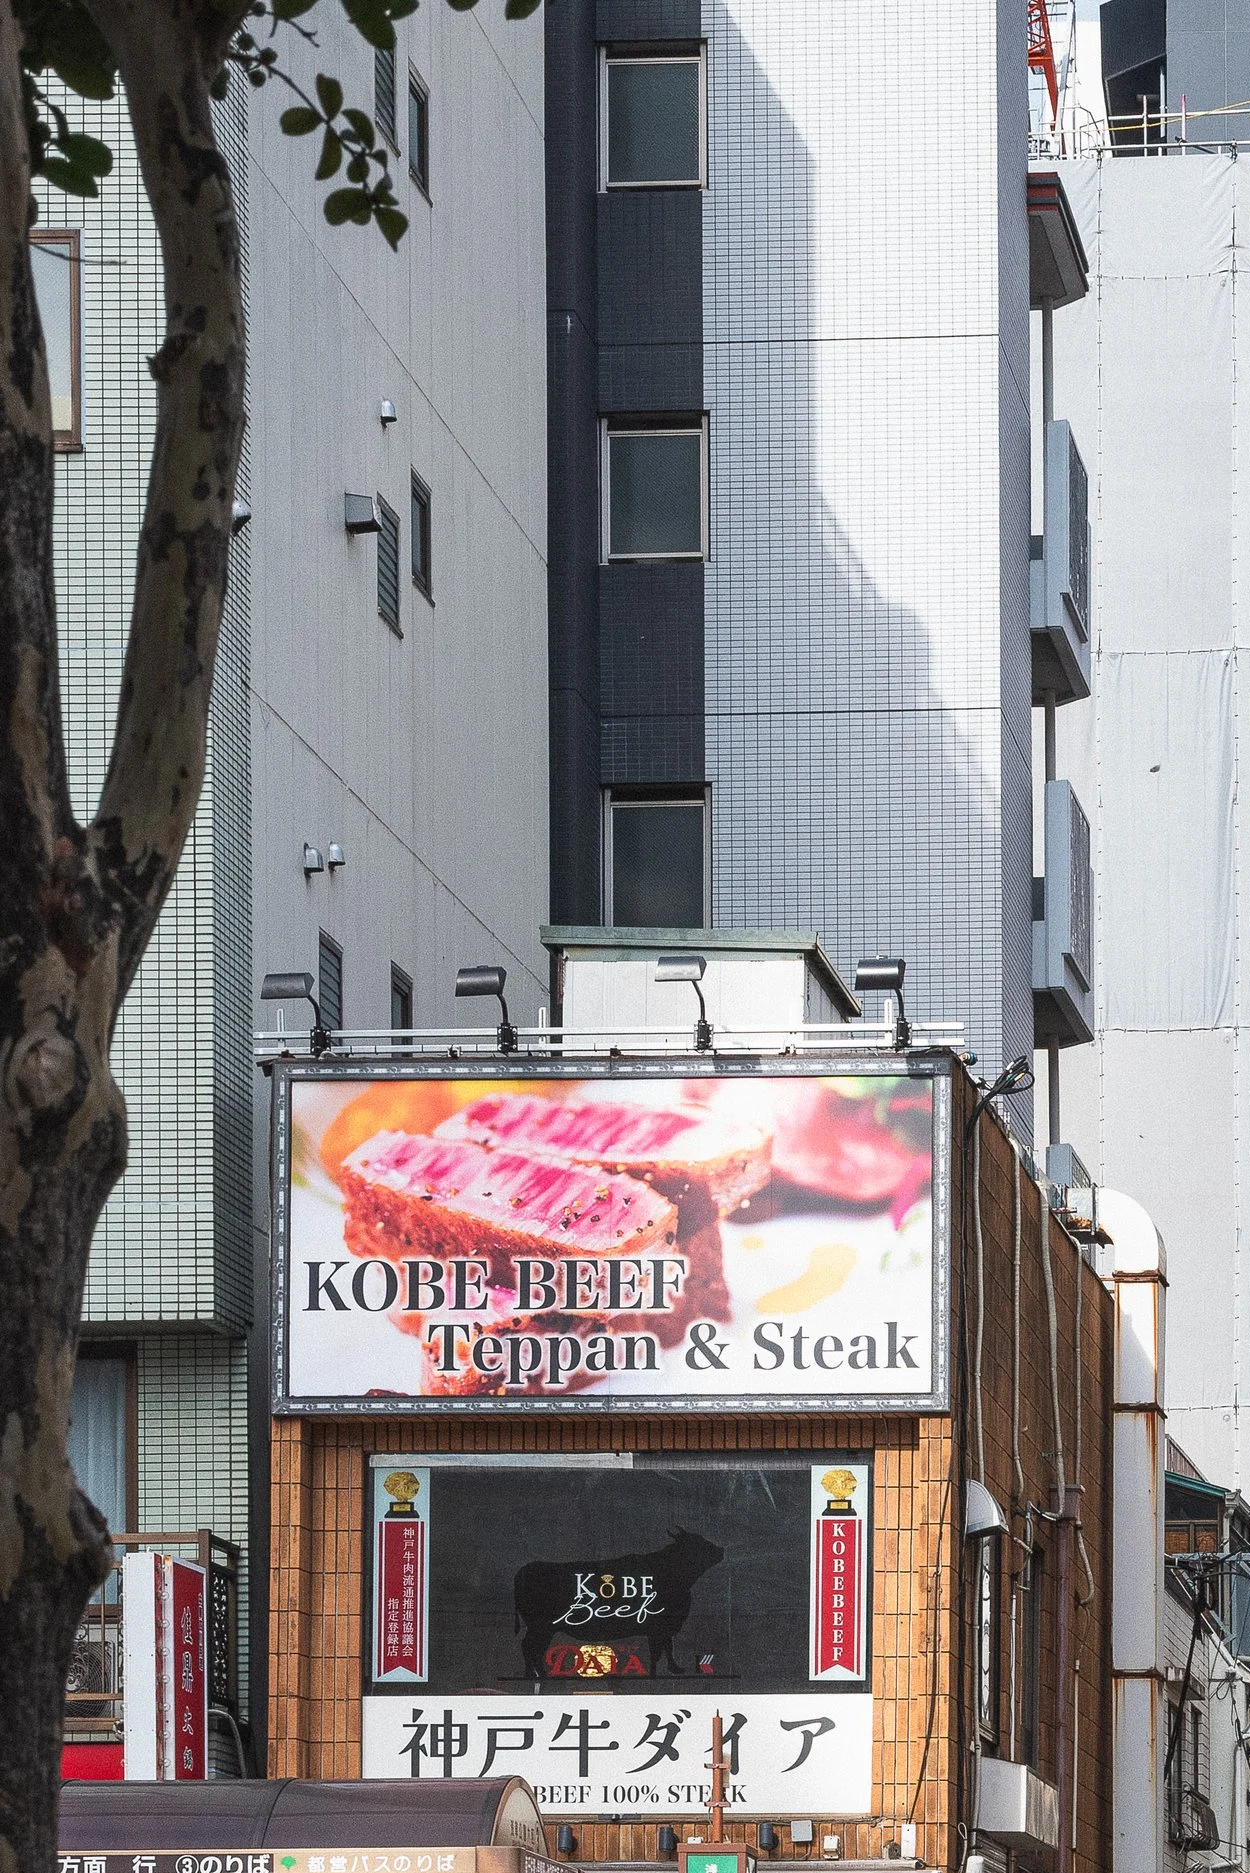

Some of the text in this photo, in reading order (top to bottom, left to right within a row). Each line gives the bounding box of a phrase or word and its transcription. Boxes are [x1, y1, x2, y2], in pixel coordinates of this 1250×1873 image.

[302, 1260, 685, 1312] KOBE BEEF
[427, 1322, 920, 1389] Teppan & Steak
[574, 1573, 654, 1599] KOBE
[387, 1598, 400, 1657] 指定登録店
[552, 1592, 665, 1626] Beef
[399, 1707, 837, 1779] 神戸牛ダイア
[533, 1785, 748, 1804] BEEF 100% STEK
[306, 1855, 455, 1873] 都営バスのりば
